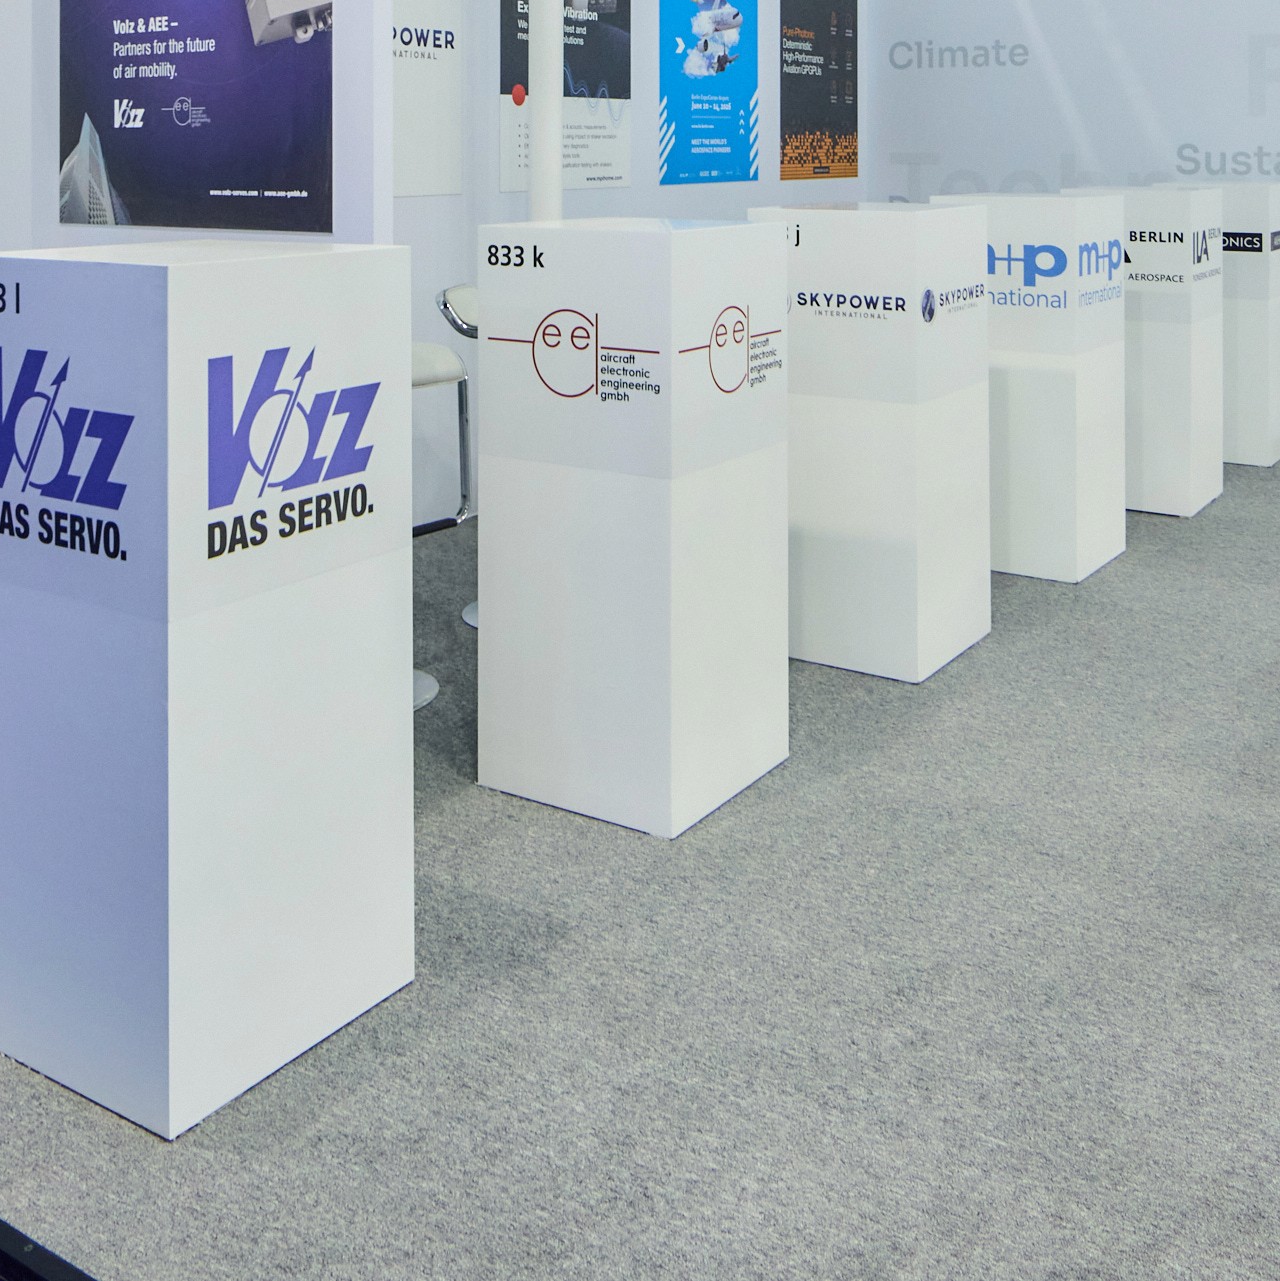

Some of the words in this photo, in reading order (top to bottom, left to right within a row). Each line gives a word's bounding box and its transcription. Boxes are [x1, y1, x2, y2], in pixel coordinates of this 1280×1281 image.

[113, 19, 135, 34] Volz
[137, 18, 146, 33] &
[148, 16, 169, 32] AEE
[113, 42, 152, 57] Partners
[153, 40, 167, 54] for
[169, 39, 184, 53] the
[186, 37, 216, 53] future
[888, 38, 1029, 71] Climate
[113, 64, 124, 79] of
[124, 63, 137, 78] air
[139, 62, 178, 80] mobility.
[794, 224, 800, 247] j
[1130, 230, 1184, 243] BERLIN
[487, 245, 524, 266] 833
[533, 245, 544, 267] k
[1193, 230, 1209, 265] ILA
[1128, 273, 1184, 282] AEROSPACE
[797, 292, 907, 311] SKYPOWER
[939, 283, 985, 307] SKYPOWER
[814, 309, 888, 320] INTERNATIONAL
[750, 337, 770, 350] aircraft
[600, 353, 636, 365] aircraft
[750, 348, 777, 362] electronic
[600, 365, 651, 379] electronic
[750, 358, 783, 375] engineering
[600, 379, 661, 395] engineering
[750, 374, 767, 388] gmbh
[600, 391, 630, 403] gmbh
[208, 510, 267, 559] DAS
[279, 483, 374, 538] SERVO.
[38, 507, 127, 561] SERVO.
